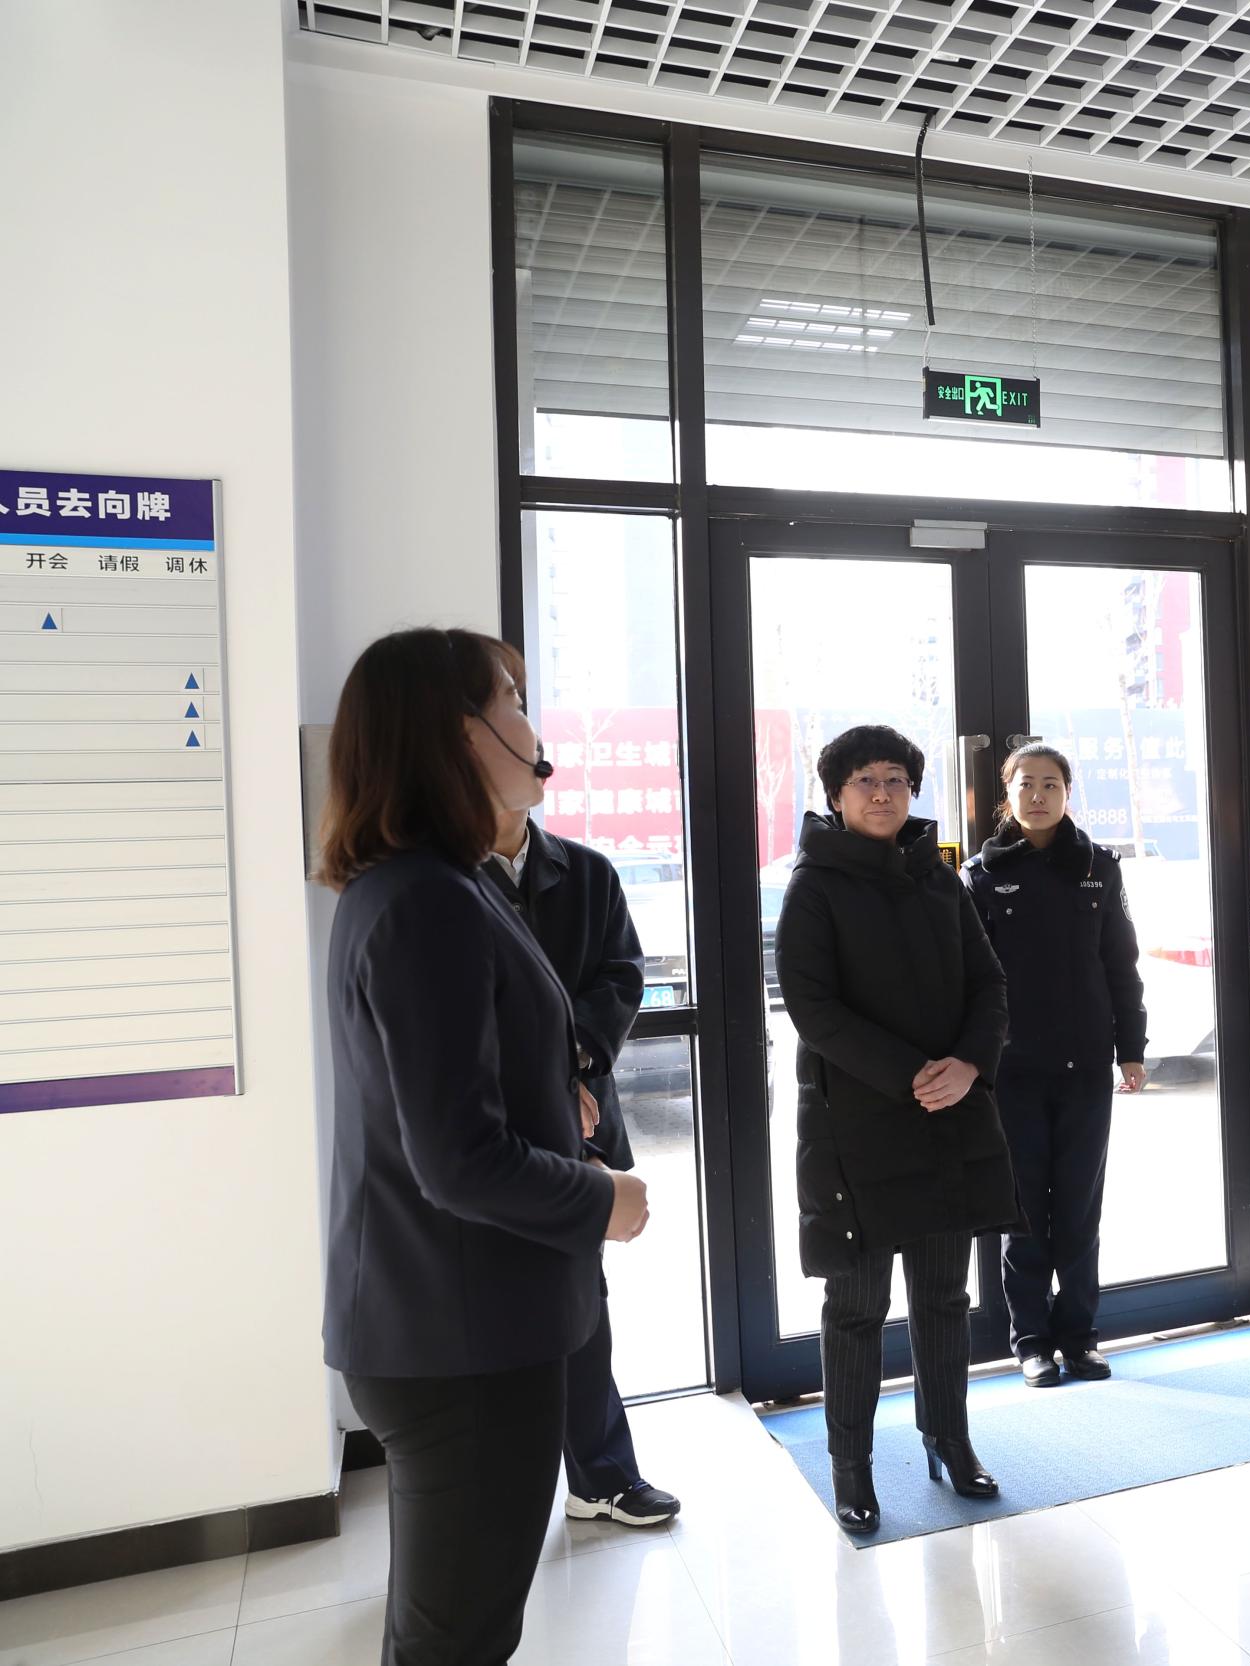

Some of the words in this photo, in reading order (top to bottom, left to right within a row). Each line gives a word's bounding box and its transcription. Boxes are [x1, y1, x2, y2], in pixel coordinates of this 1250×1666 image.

[937, 386, 964, 400] 安全出口
[1002, 391, 1028, 406] EXIT
[0, 486, 171, 521] 员去向牌
[26, 552, 69, 570] 开会
[98, 555, 140, 572] 请假
[166, 556, 208, 573] 调休
[544, 741, 679, 769] 家卫生城
[544, 787, 681, 815] 家健康城
